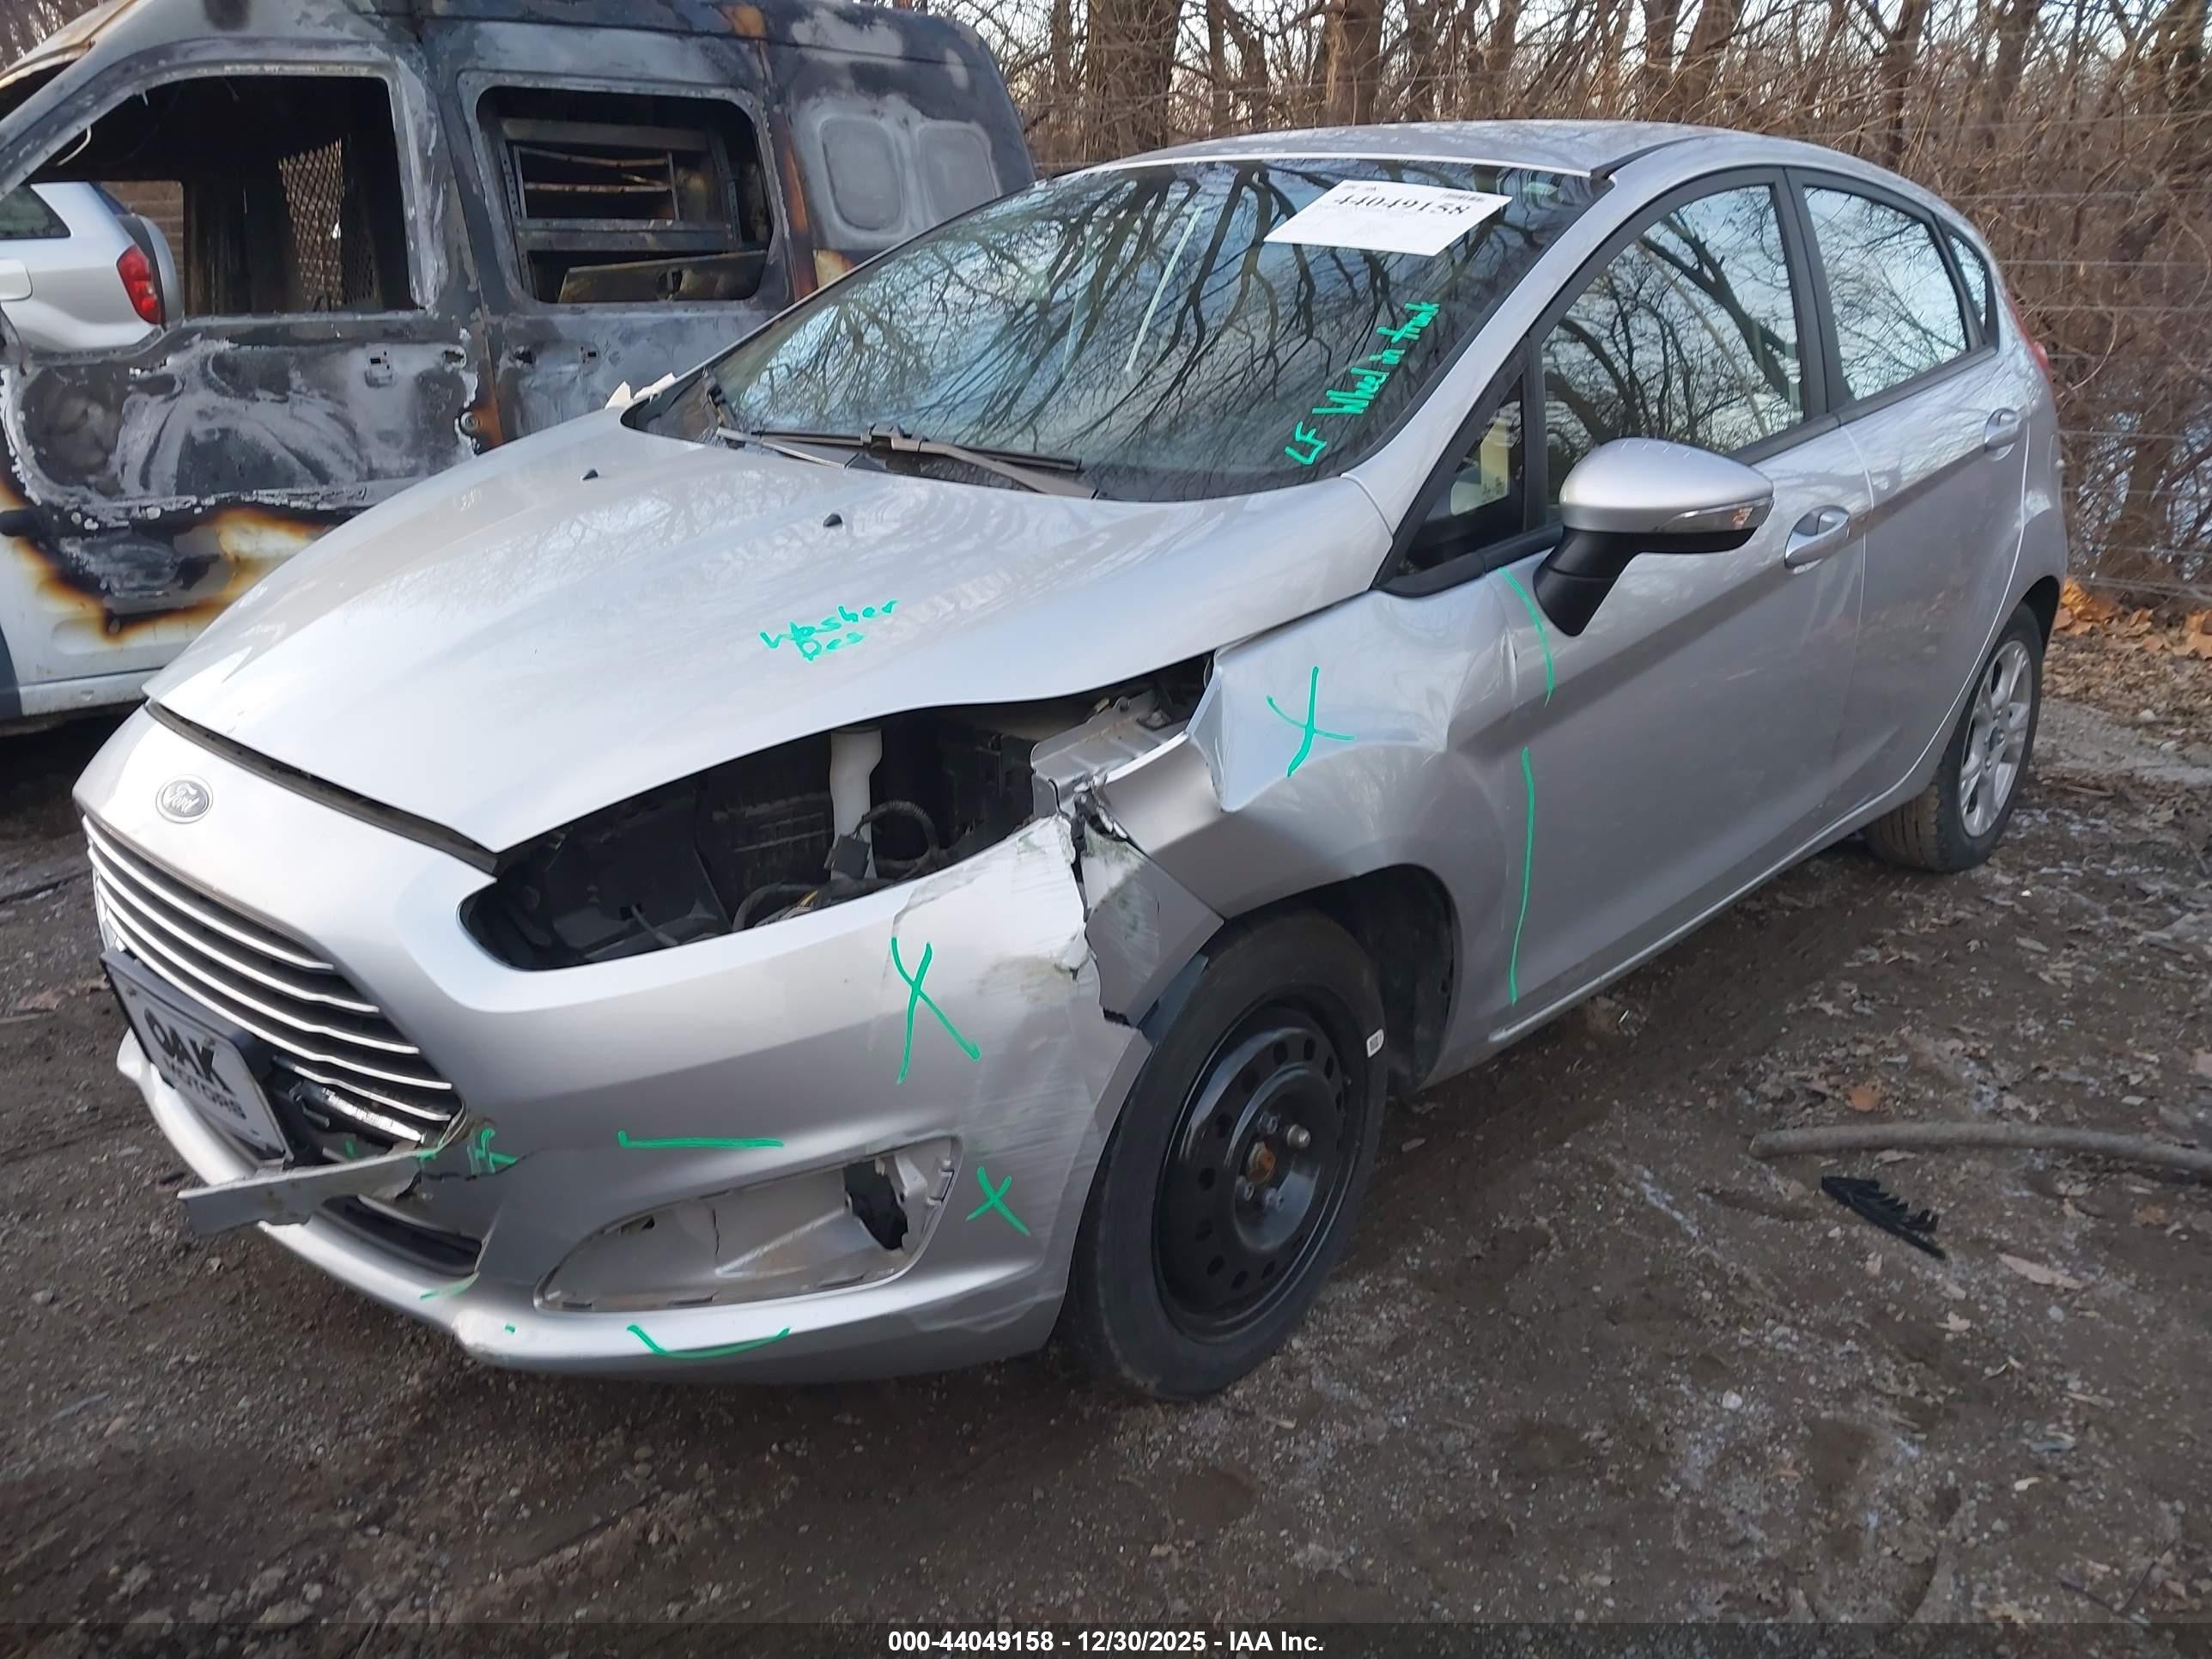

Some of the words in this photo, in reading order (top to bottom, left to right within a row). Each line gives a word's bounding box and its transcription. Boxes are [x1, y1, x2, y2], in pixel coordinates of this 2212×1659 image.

[1334, 191, 1470, 215] 44049158
[1284, 421, 1328, 465] LF
[170, 781, 200, 815] Ford
